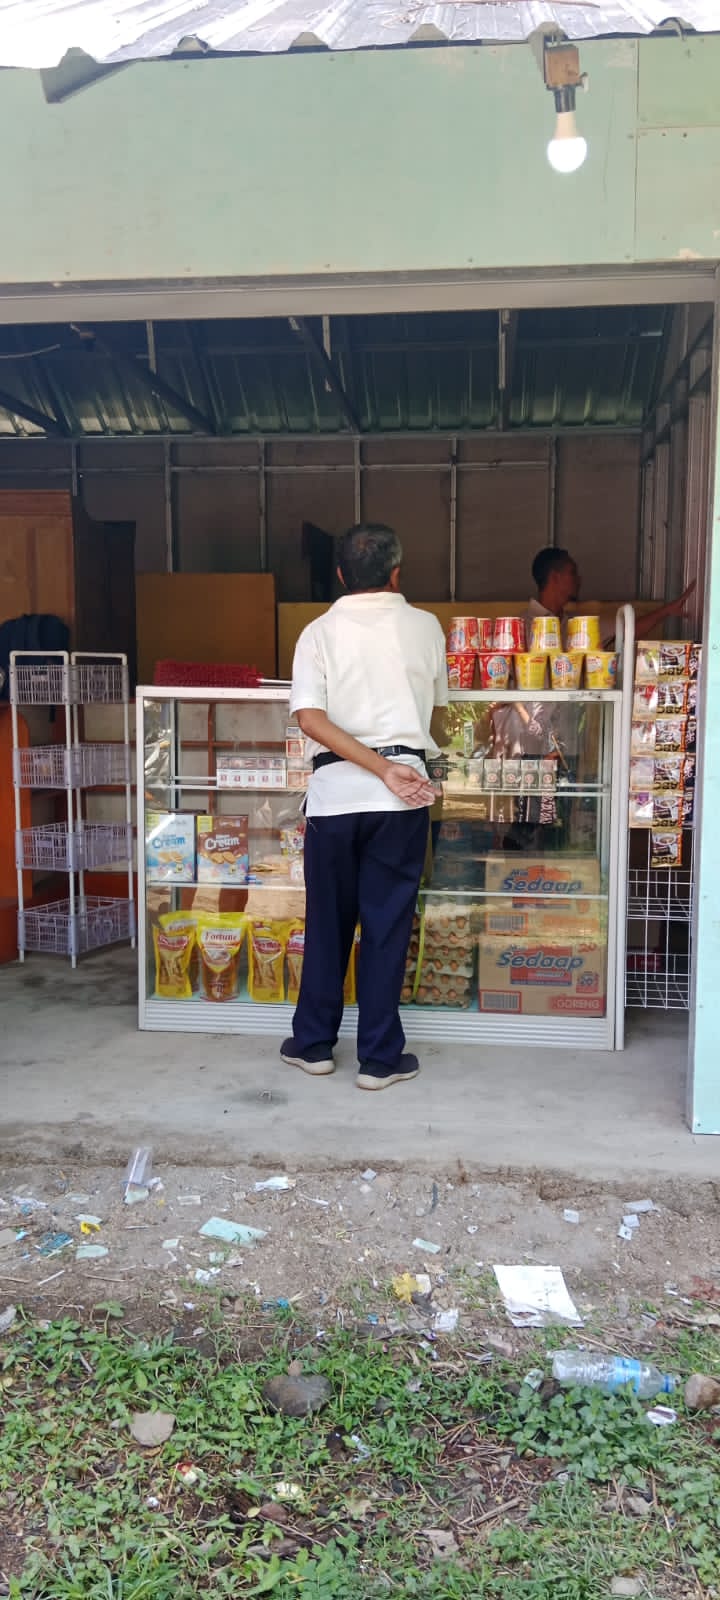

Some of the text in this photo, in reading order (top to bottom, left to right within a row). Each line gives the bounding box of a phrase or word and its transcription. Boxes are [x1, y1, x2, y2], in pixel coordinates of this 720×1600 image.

[205, 836, 240, 850] Cream
[502, 876, 582, 894] Sedaap
[496, 951, 585, 971] Sedaap
[556, 999, 600, 1009] GORENG
